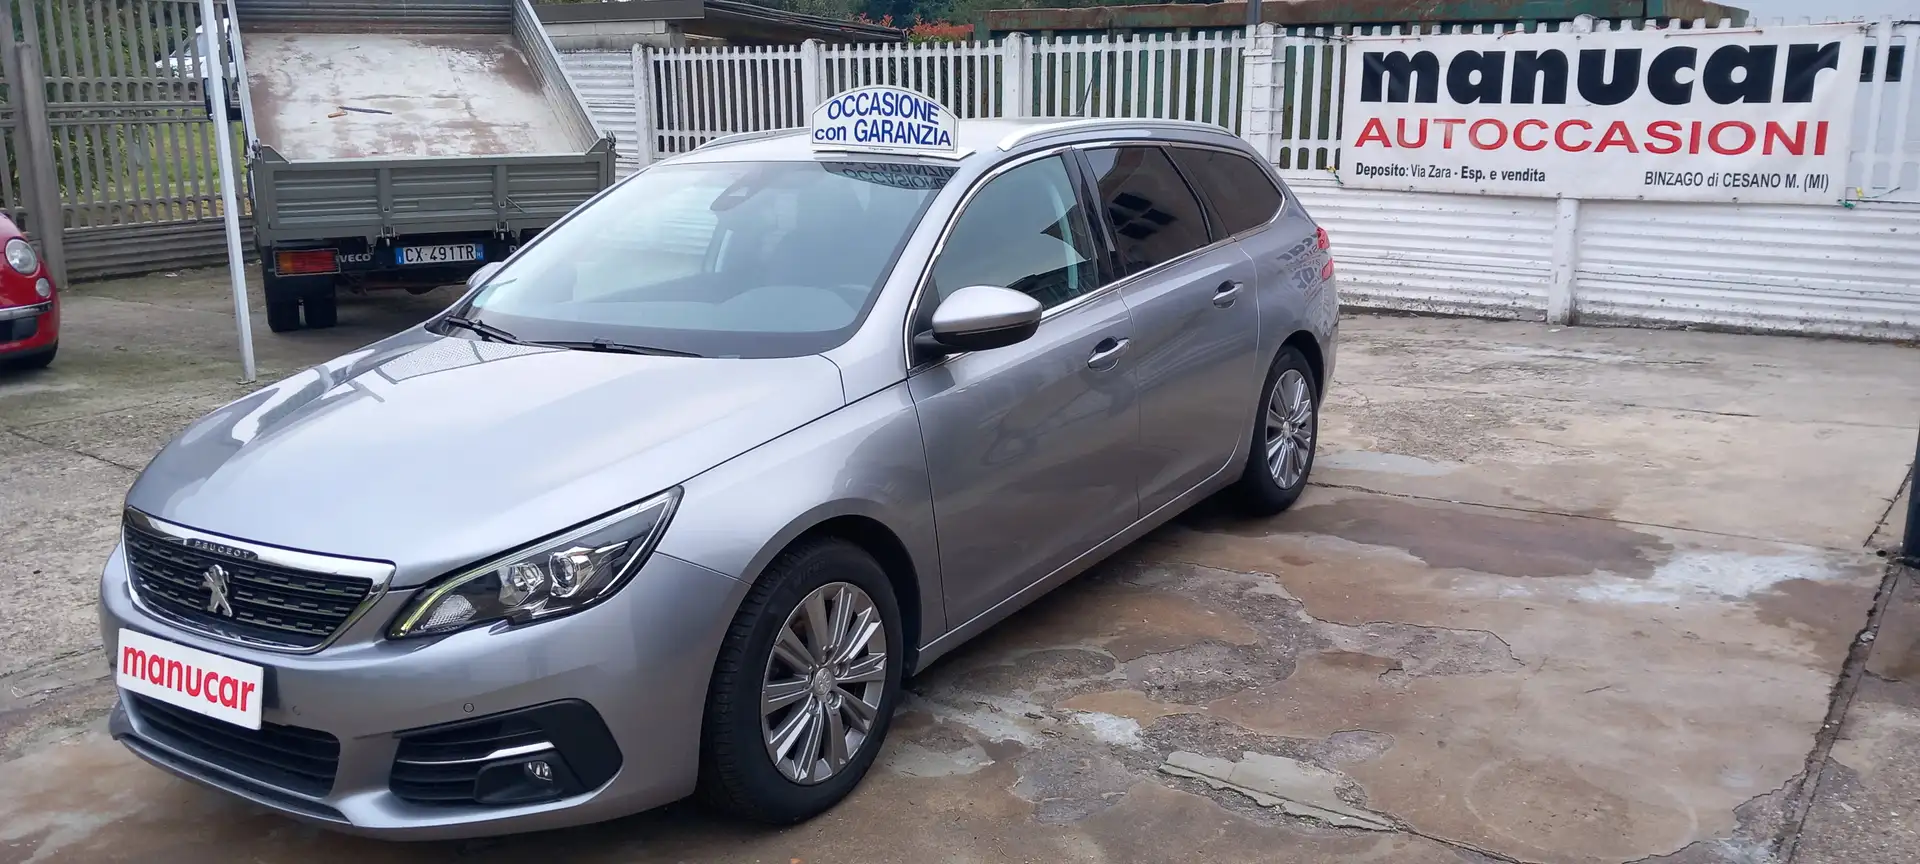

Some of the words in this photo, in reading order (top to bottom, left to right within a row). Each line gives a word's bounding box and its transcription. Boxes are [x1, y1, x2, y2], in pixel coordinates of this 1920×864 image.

[1361, 40, 1840, 105] manucar
[828, 92, 940, 125] OCCASIONE
[814, 125, 847, 141] con
[854, 119, 951, 146] GARANZIA
[1354, 117, 1829, 156] AUTOCCASIONI
[1356, 162, 1409, 178] Deposito:
[1411, 164, 1426, 178] Via
[1428, 165, 1451, 178] Zara
[1461, 166, 1486, 182] Esp.
[1490, 171, 1497, 180] e
[1501, 168, 1546, 182] vendita
[1644, 171, 1703, 187] BINZAGO
[1707, 172, 1719, 187] di
[1722, 173, 1781, 188] CESANO
[1785, 174, 1799, 188] M.
[1804, 174, 1829, 193] (MI)
[195, 540, 249, 559] PEUGEOT
[123, 646, 255, 711] manucar
